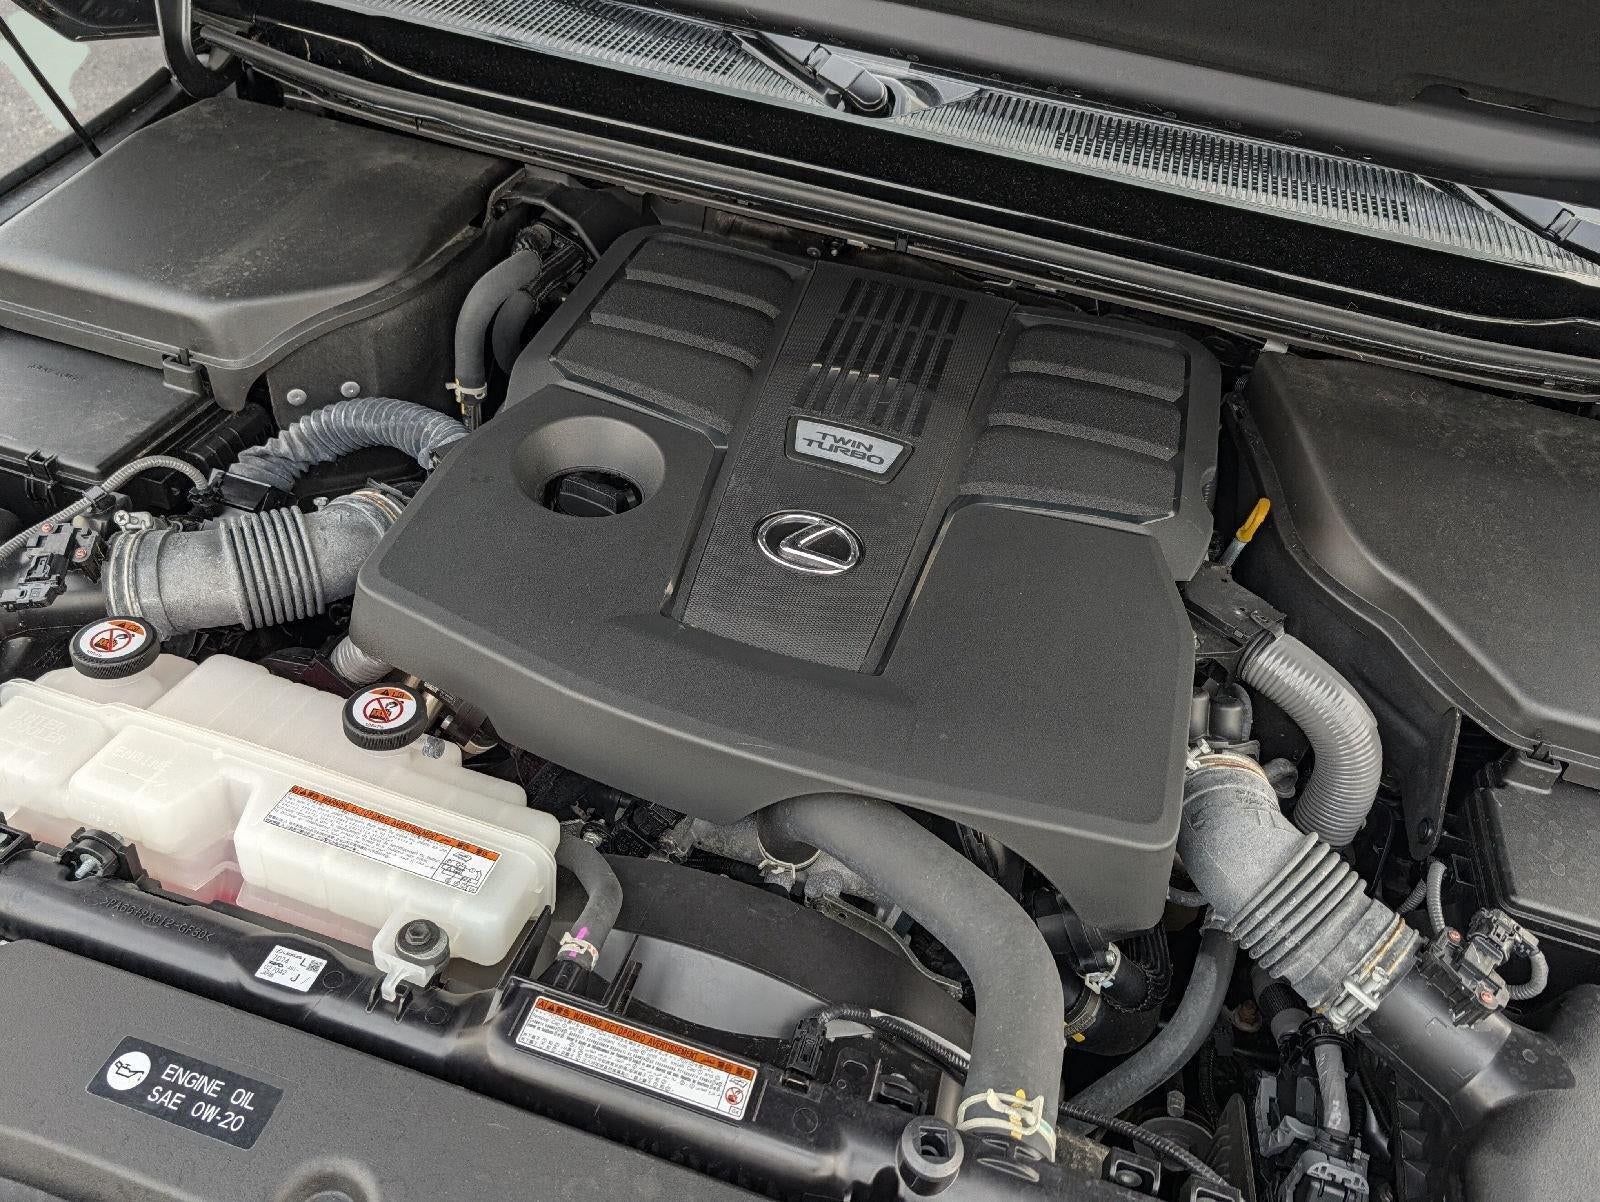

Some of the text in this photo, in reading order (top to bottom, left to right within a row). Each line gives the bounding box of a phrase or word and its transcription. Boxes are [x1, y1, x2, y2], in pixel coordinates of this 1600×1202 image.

[802, 437, 885, 465] TURBO
[815, 431, 874, 452] TWIN
[573, 1011, 602, 1028] WARNING
[647, 1037, 698, 1061] AVERTISSEMENT
[160, 1063, 255, 1111] ENGINE OIL
[147, 1086, 245, 1132] SAE 0W-20
